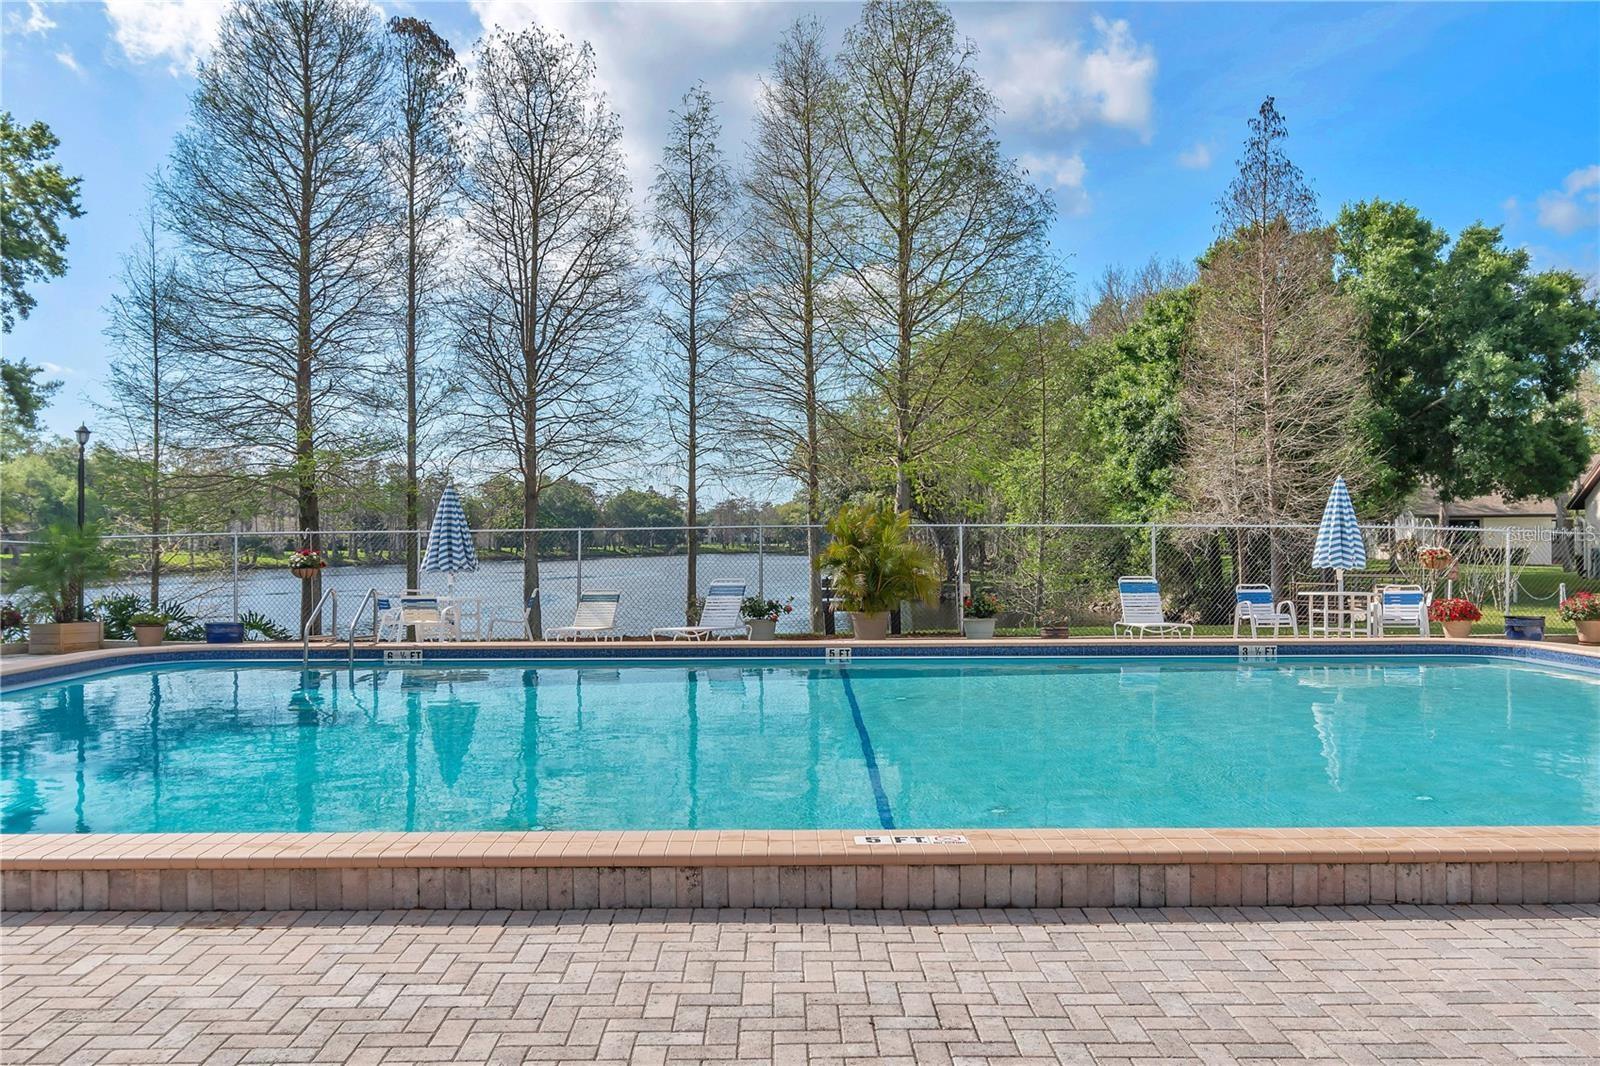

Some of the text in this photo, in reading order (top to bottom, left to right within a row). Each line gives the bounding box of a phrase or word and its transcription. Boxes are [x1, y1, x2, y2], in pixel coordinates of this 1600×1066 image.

[839, 649, 851, 657] FT
[1242, 646, 1248, 656] 3
[1264, 647, 1276, 656] FT
